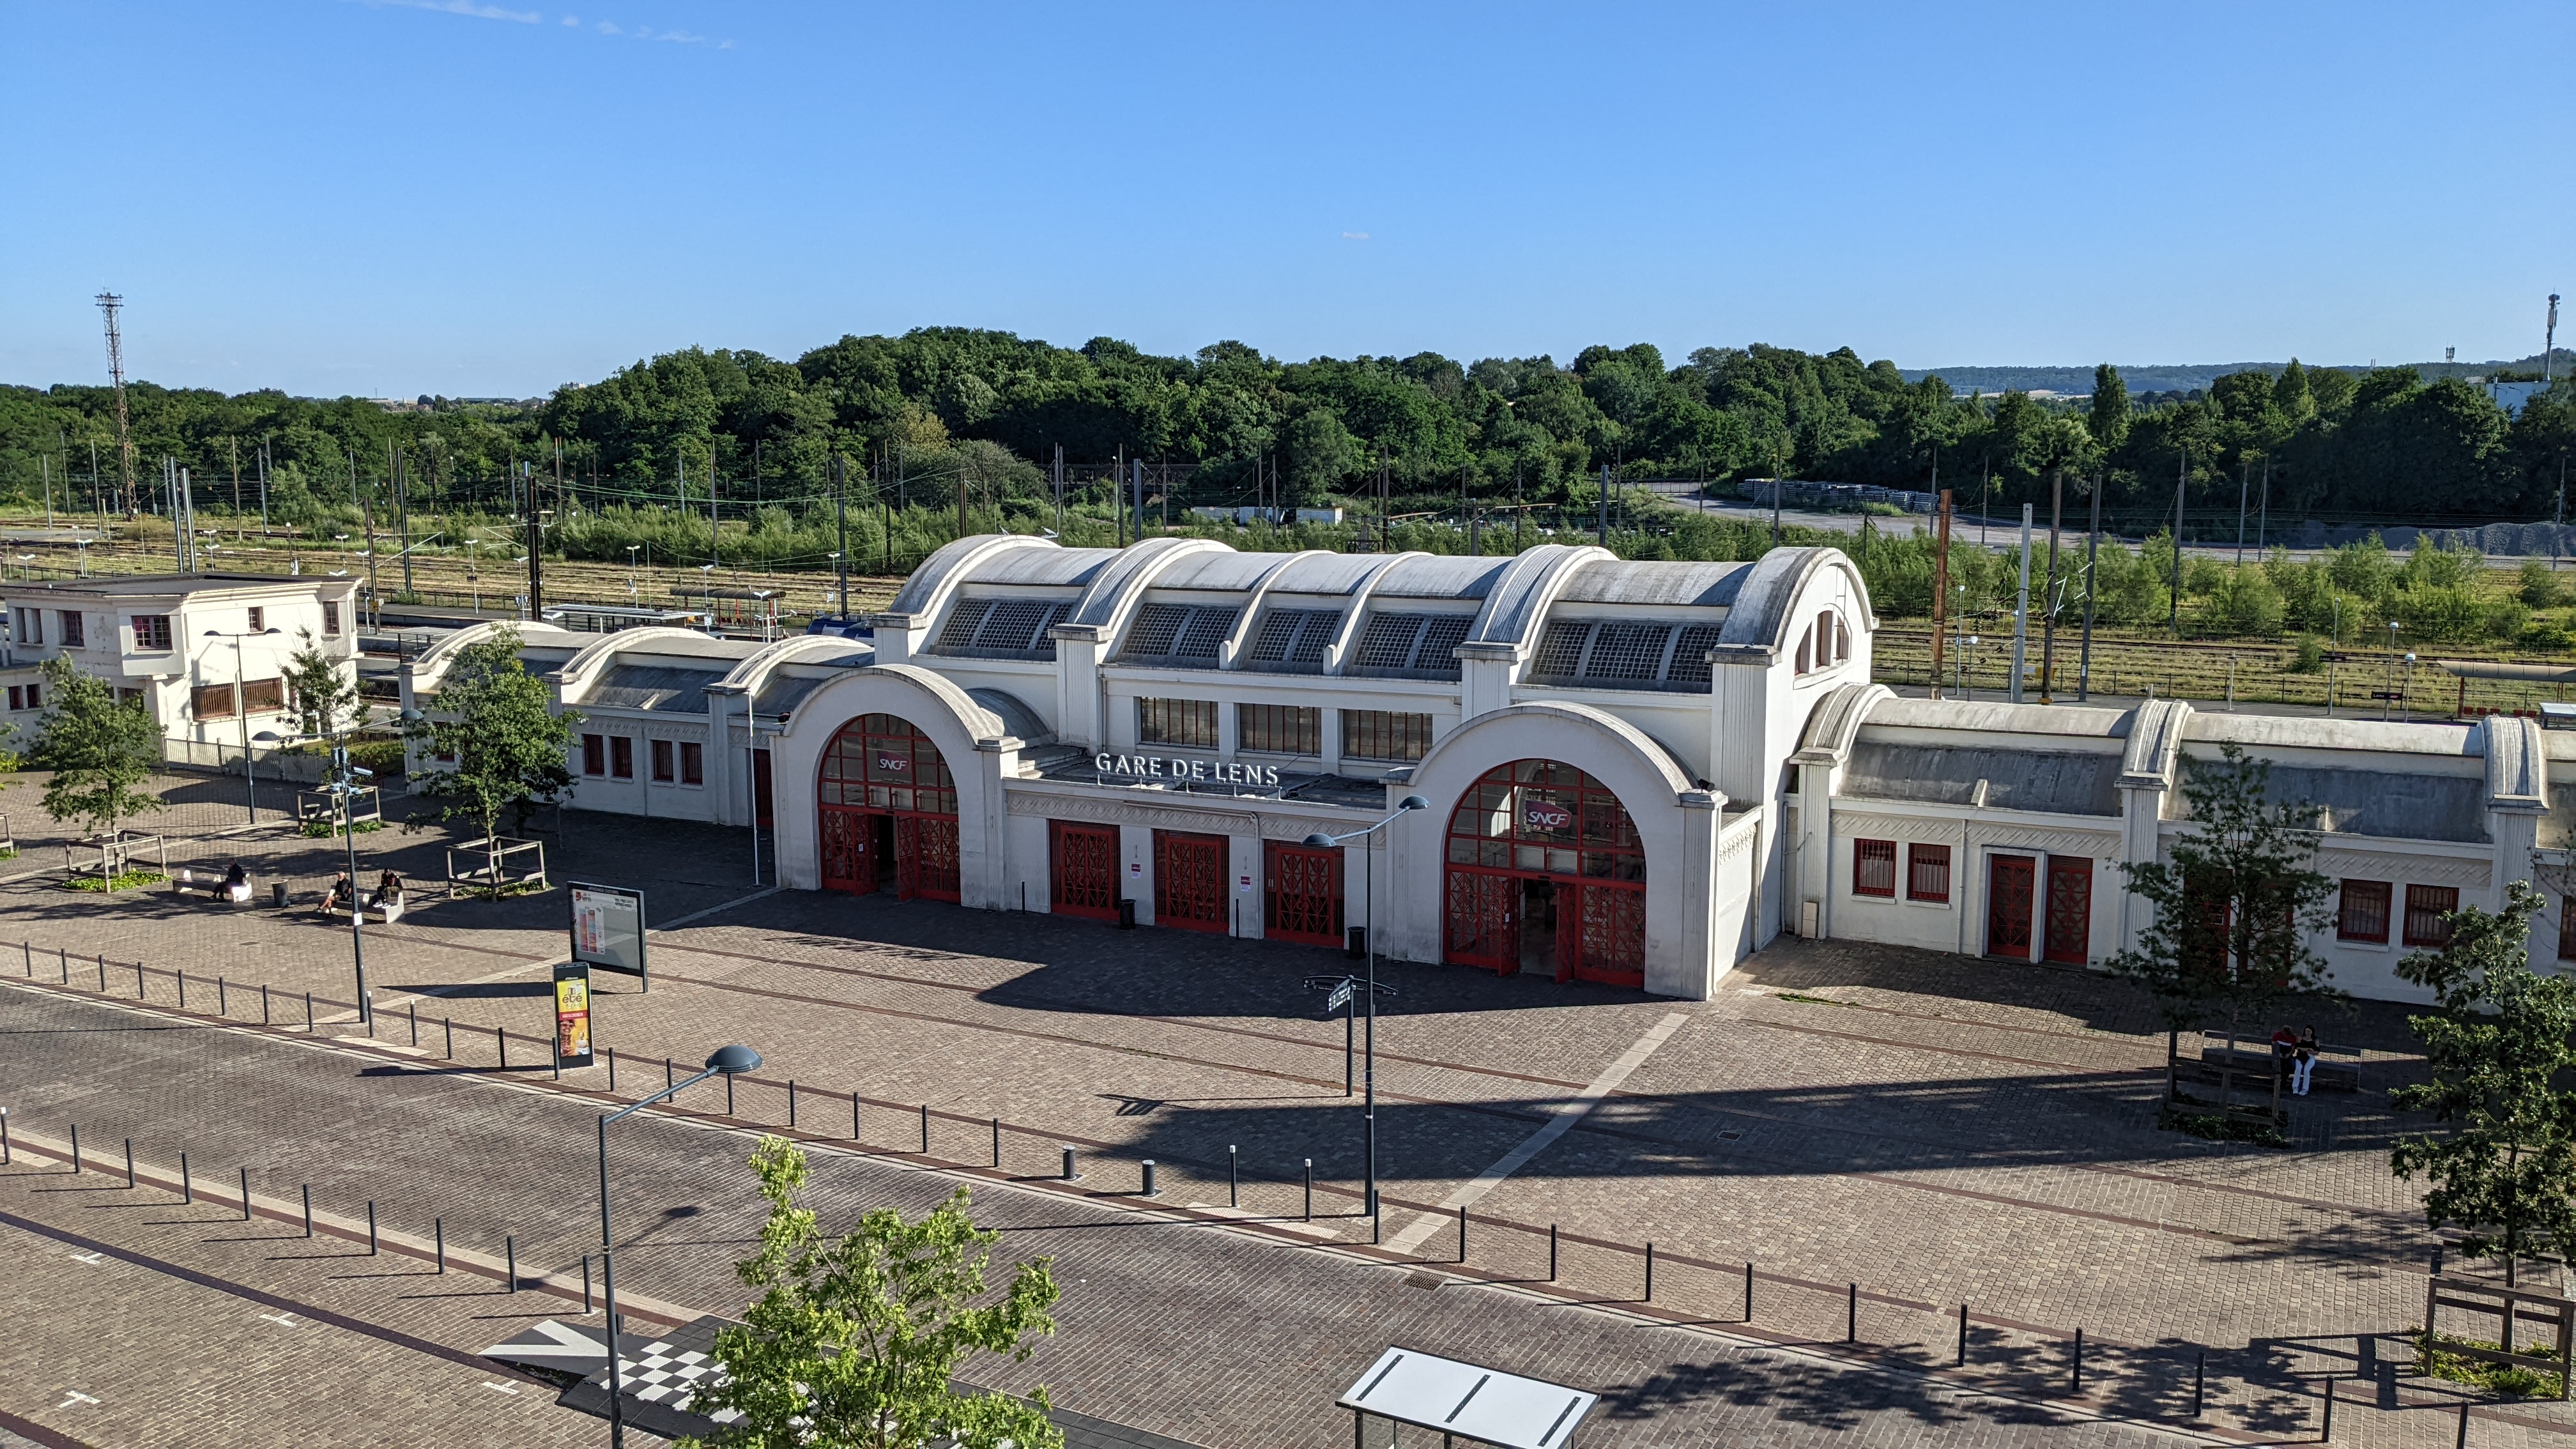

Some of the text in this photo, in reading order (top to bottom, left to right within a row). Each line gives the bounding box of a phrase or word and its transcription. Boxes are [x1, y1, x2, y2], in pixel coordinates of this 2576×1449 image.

[879, 758, 907, 770] SNCF
[1095, 753, 1278, 786] GARE DE LENS
[1528, 811, 1568, 825] SNCF
[562, 990, 583, 1003] été
